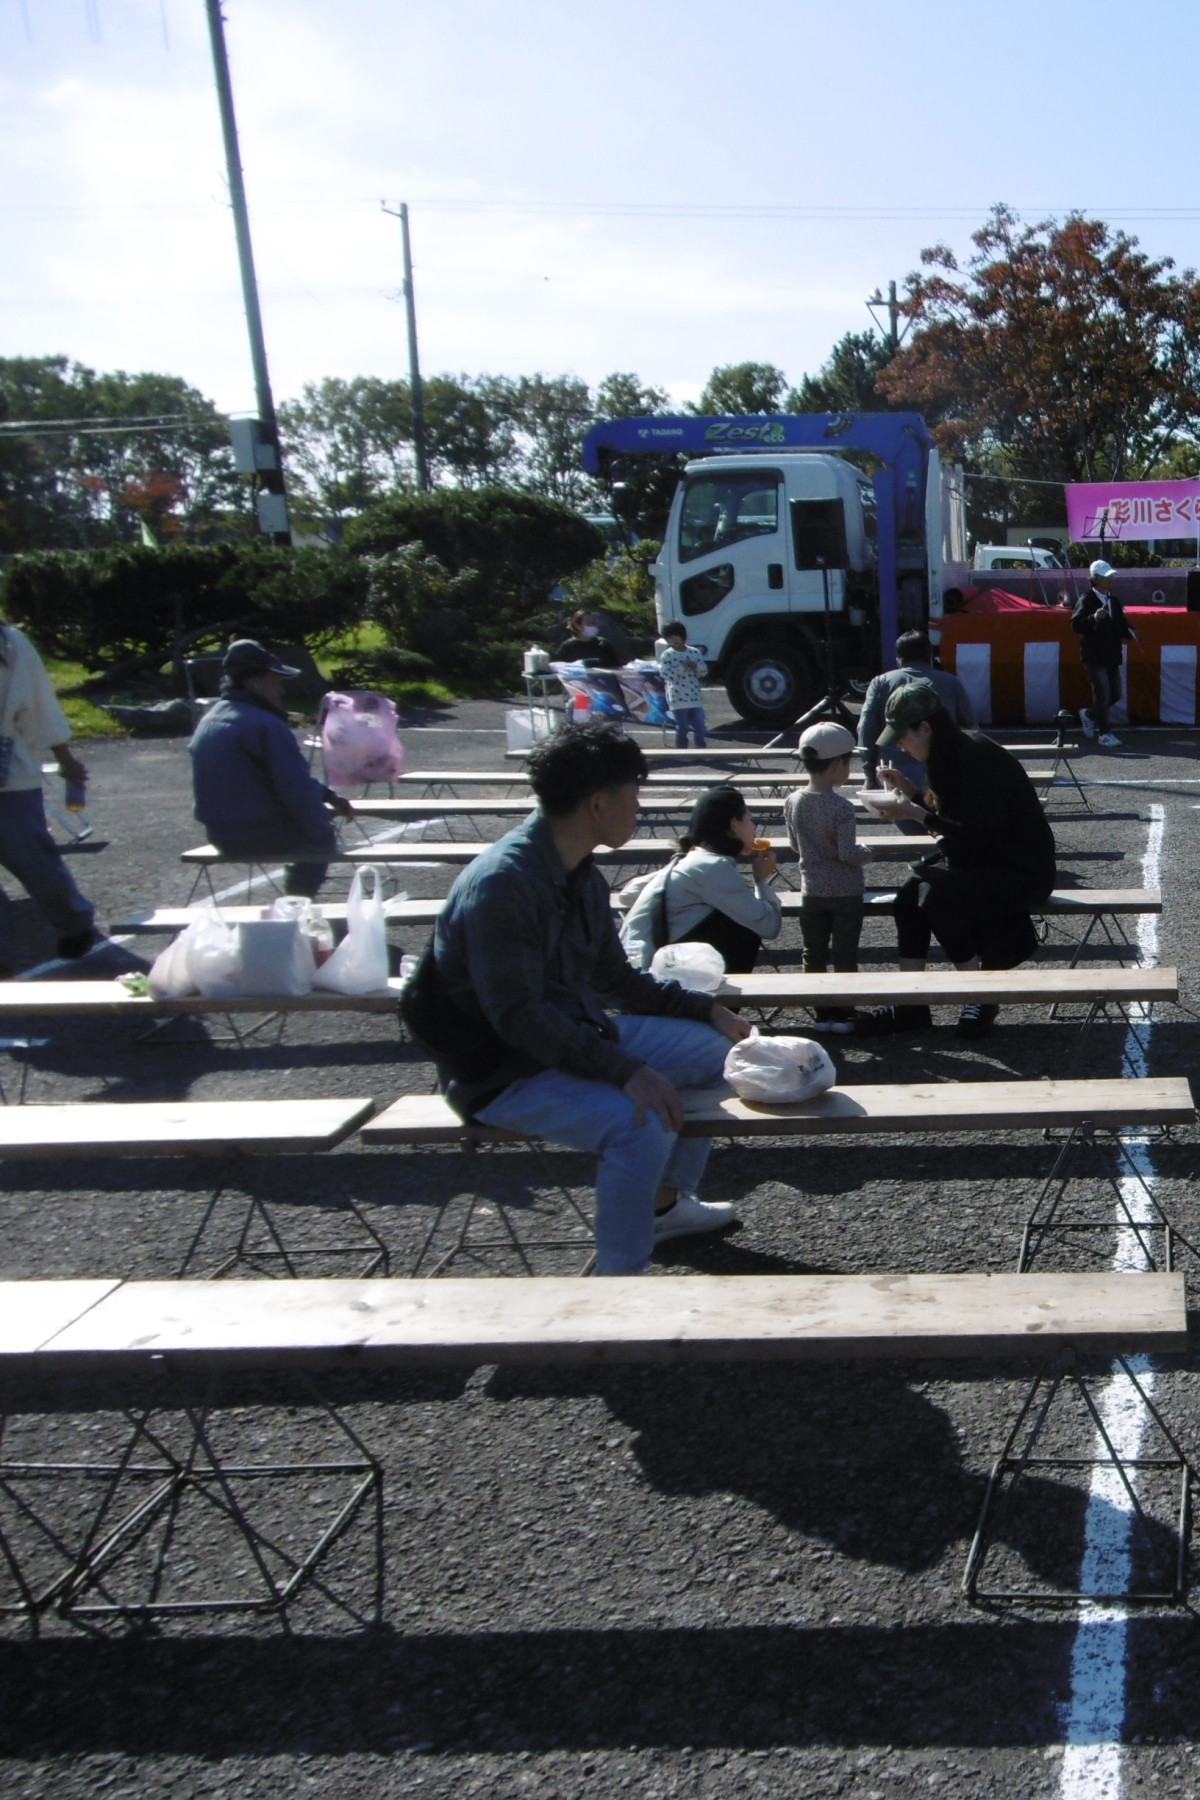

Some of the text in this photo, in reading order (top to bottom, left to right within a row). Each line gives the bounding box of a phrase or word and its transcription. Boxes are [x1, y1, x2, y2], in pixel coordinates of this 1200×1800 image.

[651, 428, 684, 436] TADANO
[705, 422, 785, 442] Zest eco
